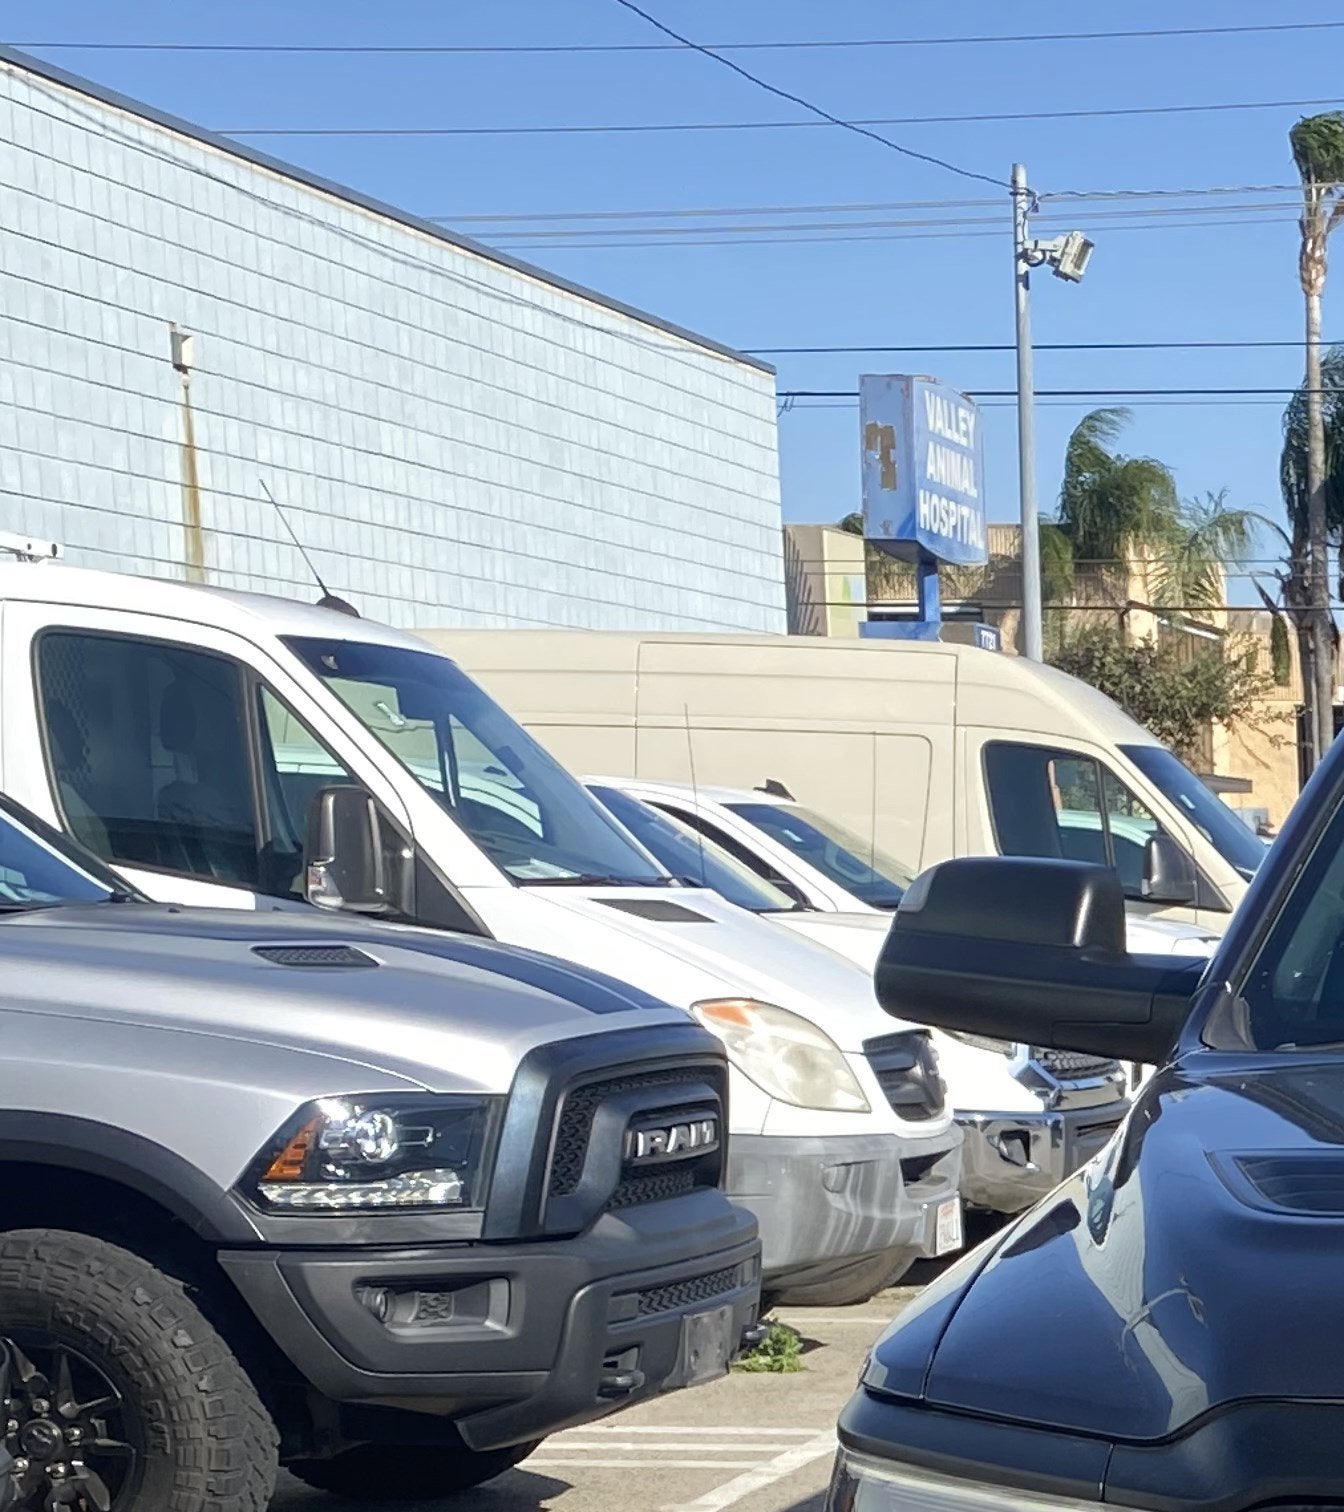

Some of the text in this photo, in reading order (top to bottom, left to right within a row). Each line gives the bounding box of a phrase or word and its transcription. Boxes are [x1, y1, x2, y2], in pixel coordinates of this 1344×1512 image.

[924, 390, 976, 449] VALLEY
[926, 441, 978, 498] ANIMAL
[919, 489, 985, 550] HOSPITAL
[637, 1120, 716, 1157] RAM
